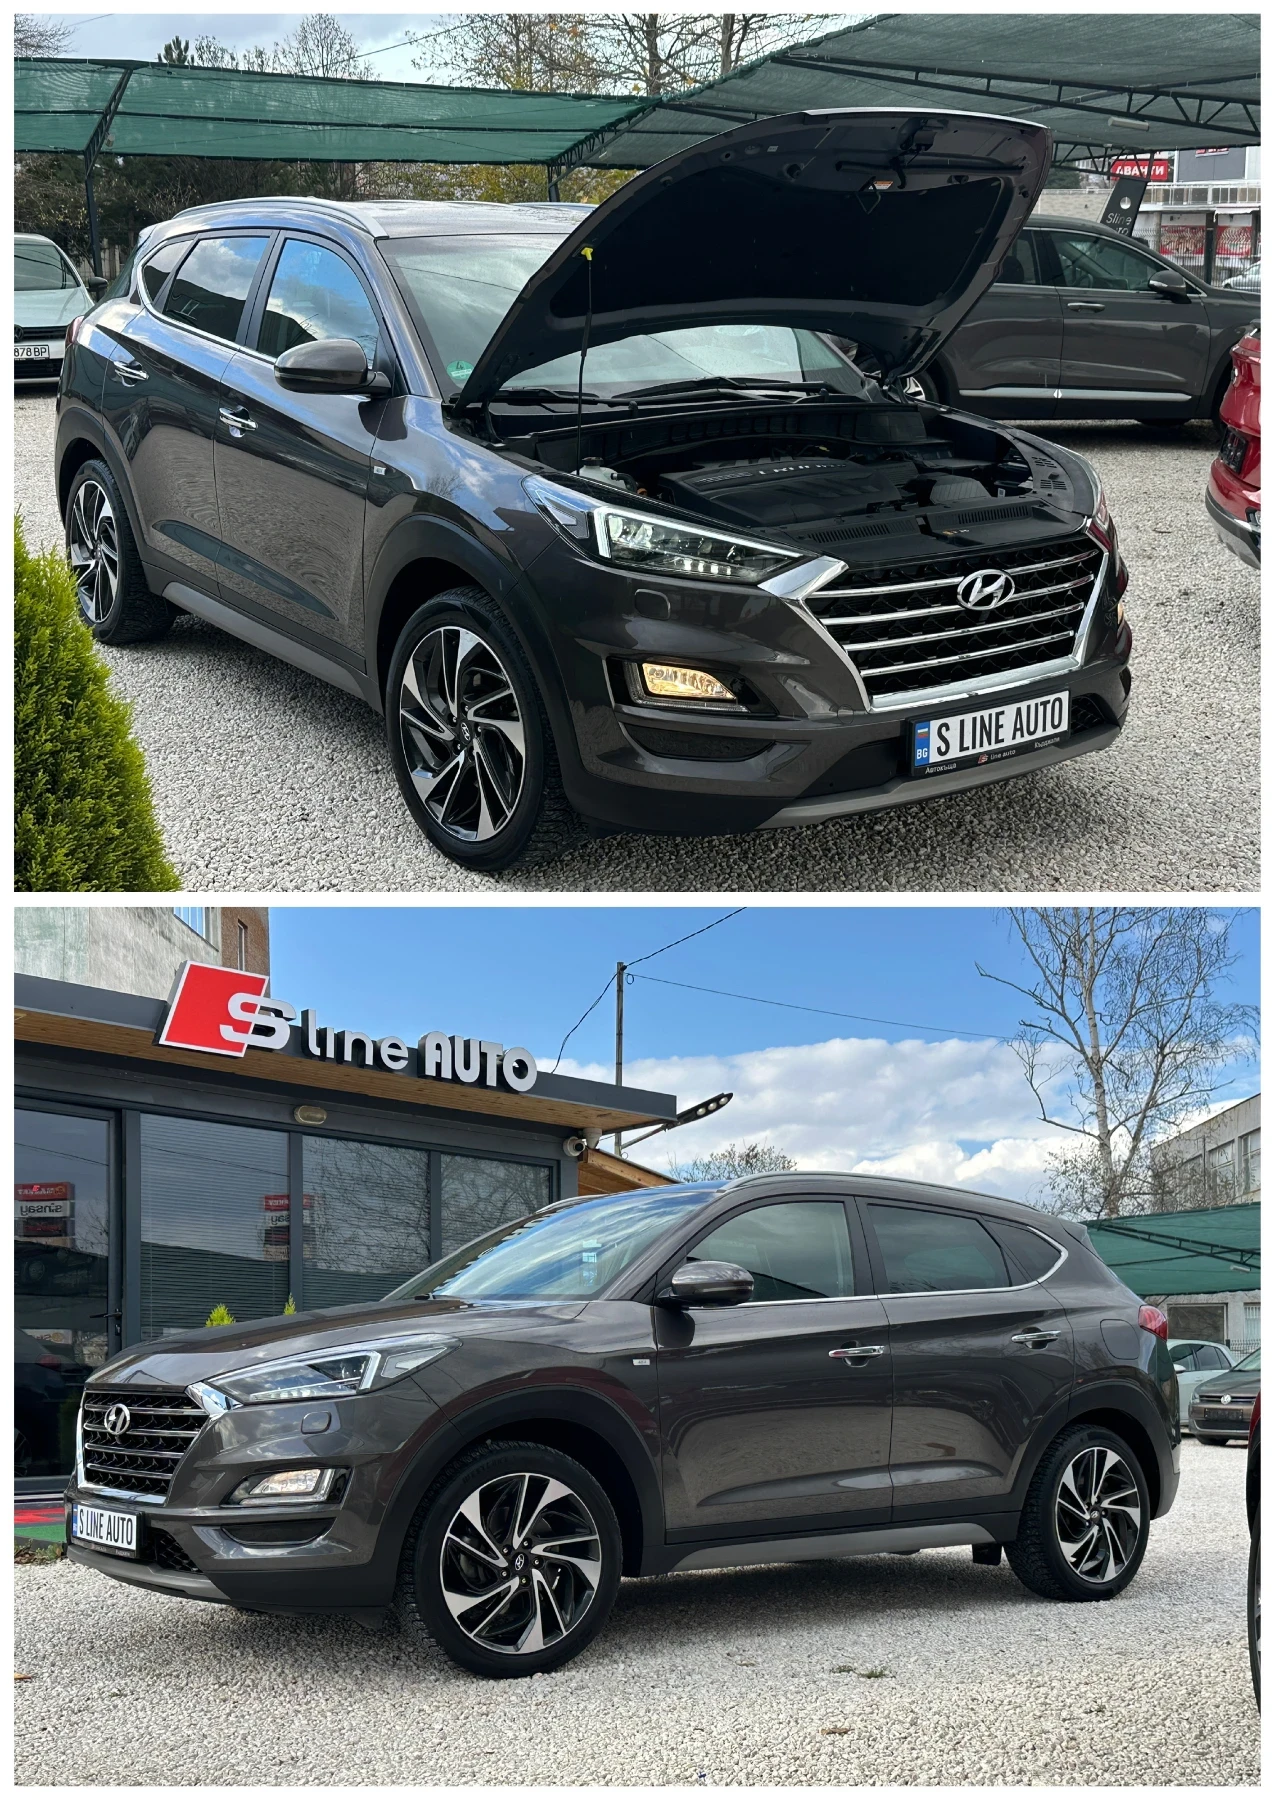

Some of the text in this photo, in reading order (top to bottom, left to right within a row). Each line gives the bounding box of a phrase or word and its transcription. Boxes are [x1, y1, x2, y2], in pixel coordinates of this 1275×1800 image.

[937, 697, 1062, 757] S LINE AUTO
[917, 748, 928, 759] BG
[1002, 749, 1016, 758] auto
[219, 992, 538, 1092] S line AUTO
[79, 1508, 133, 1546] S LINE AUTO
